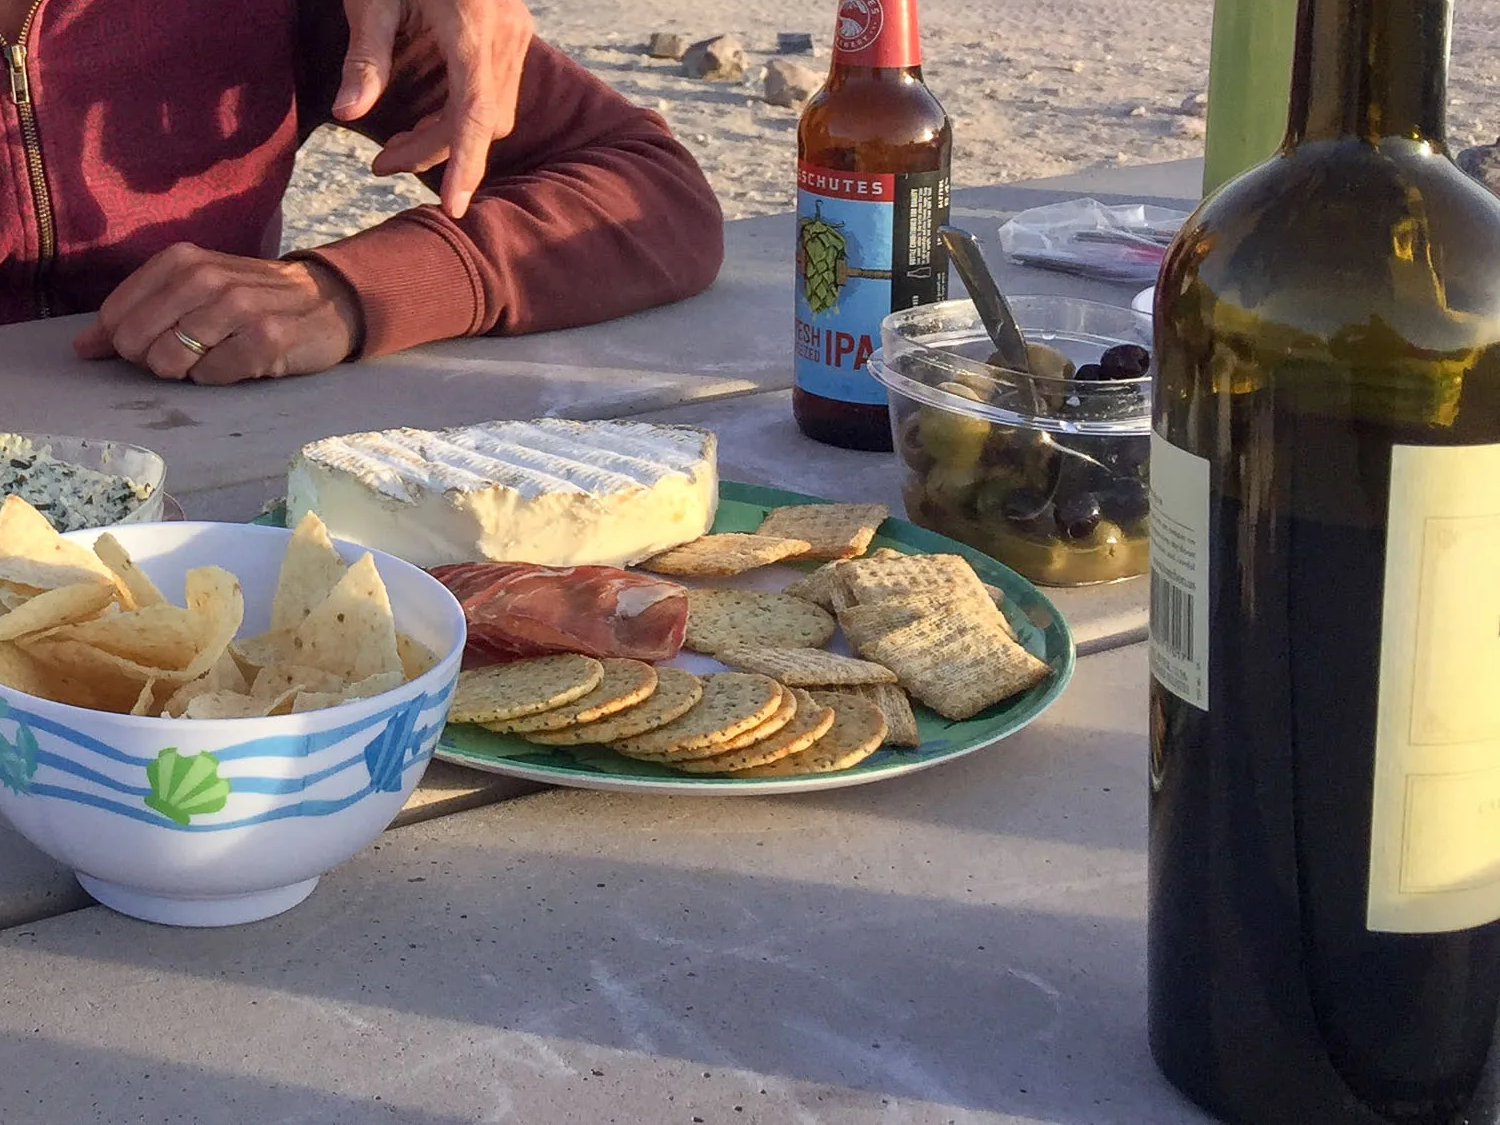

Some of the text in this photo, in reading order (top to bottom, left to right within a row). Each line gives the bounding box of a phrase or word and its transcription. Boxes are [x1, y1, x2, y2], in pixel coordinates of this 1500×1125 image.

[798, 171, 883, 195] SCHUTES
[796, 318, 820, 348] ESH
[825, 329, 873, 371] IPA
